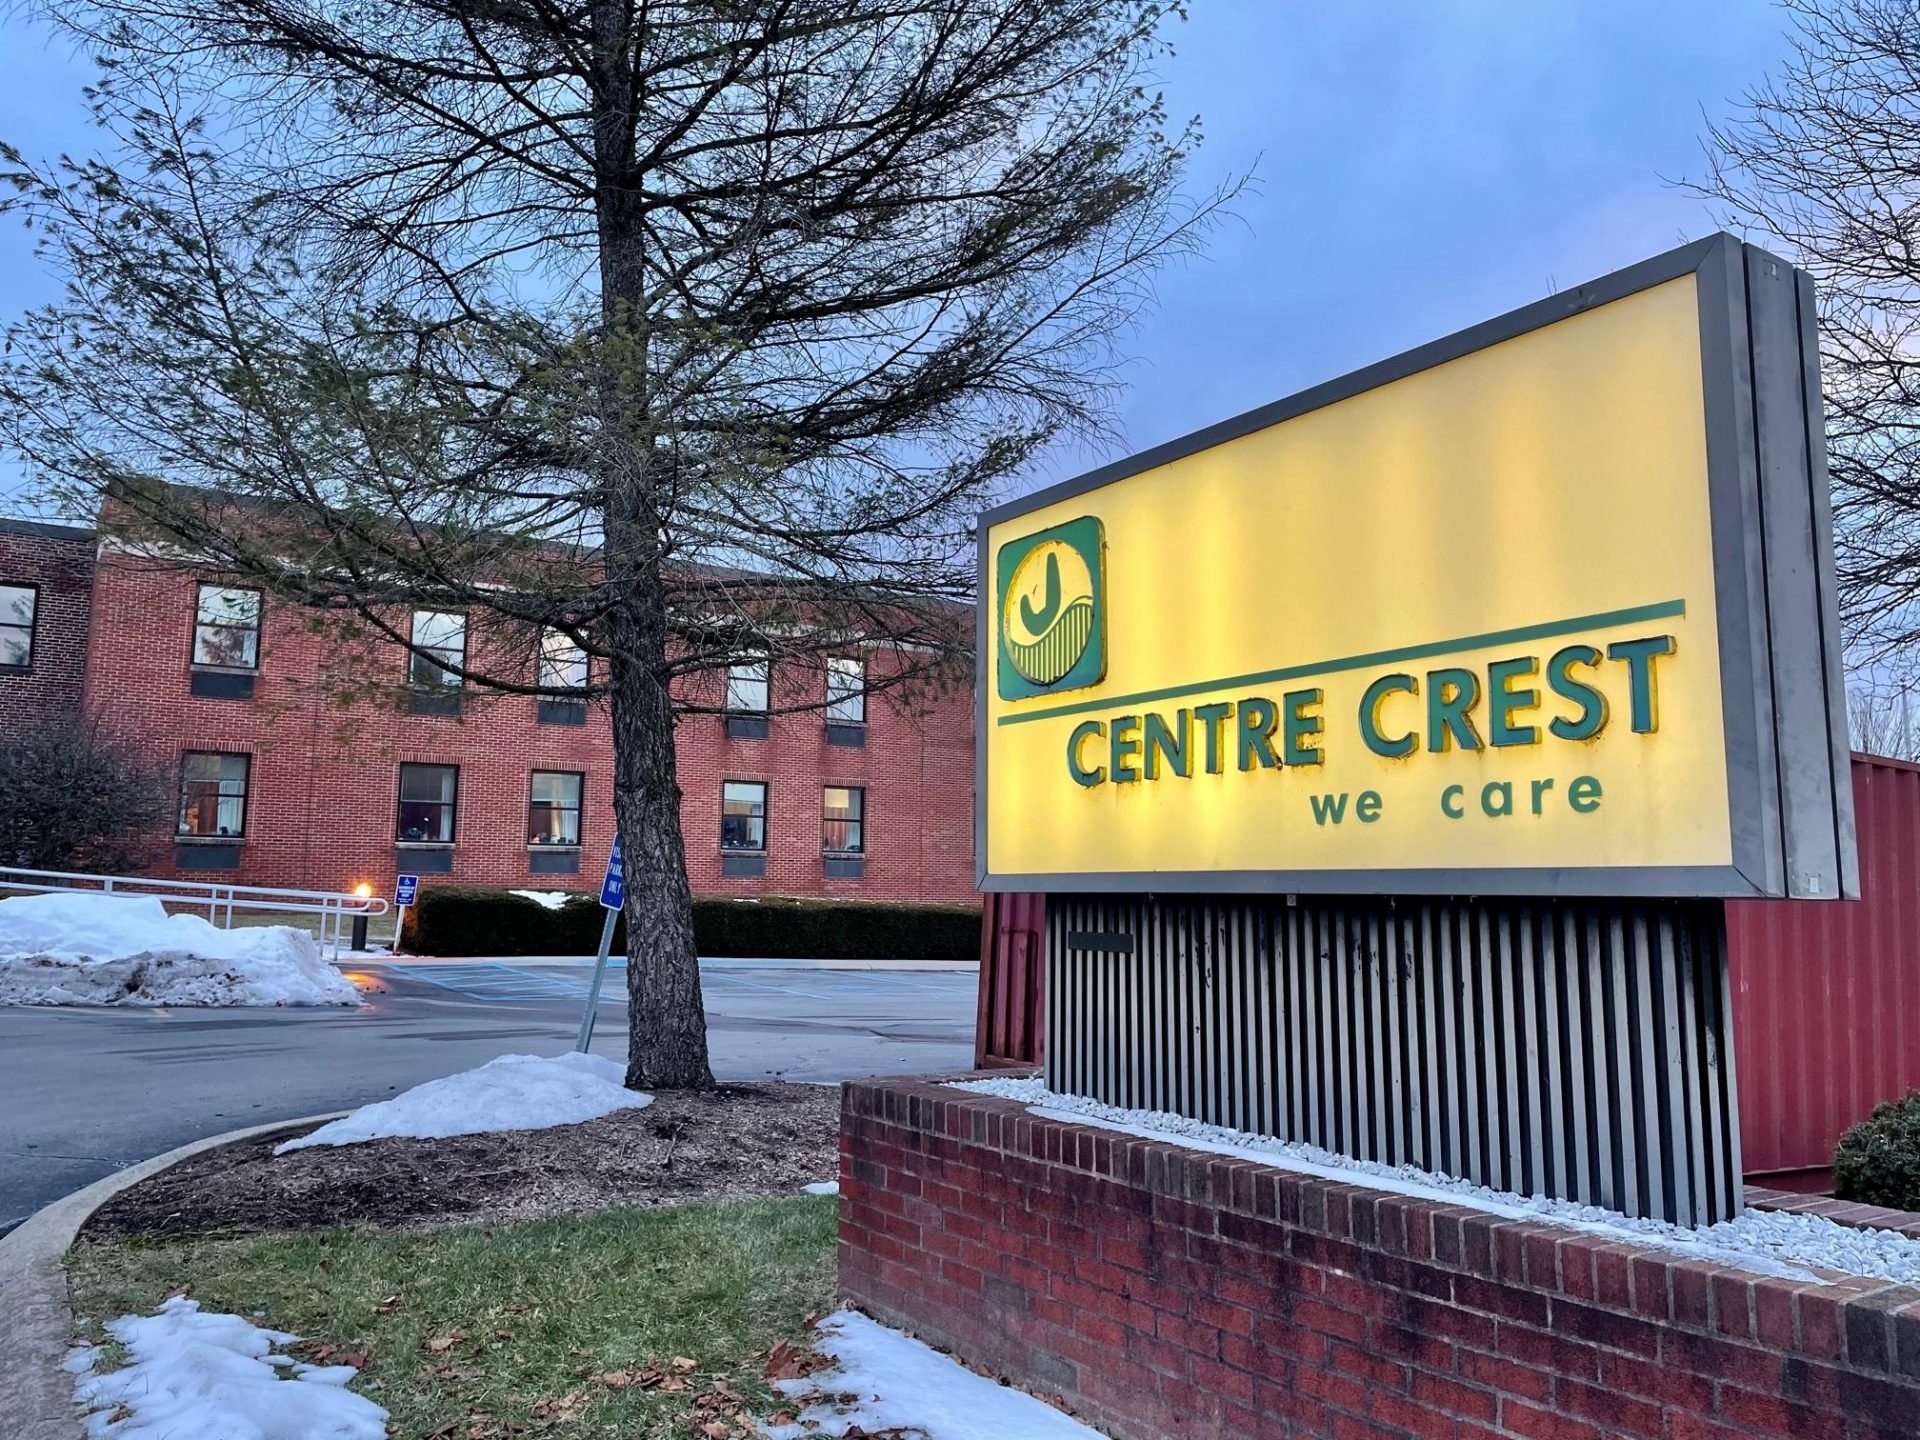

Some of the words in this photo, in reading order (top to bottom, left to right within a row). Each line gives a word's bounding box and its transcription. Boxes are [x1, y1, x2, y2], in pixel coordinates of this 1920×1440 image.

[1067, 688, 1325, 788] CENTRE
[1358, 635, 1677, 759] CREST
[1310, 789, 1383, 825] we
[1441, 775, 1603, 819] care
[608, 880, 621, 893] ONLY
